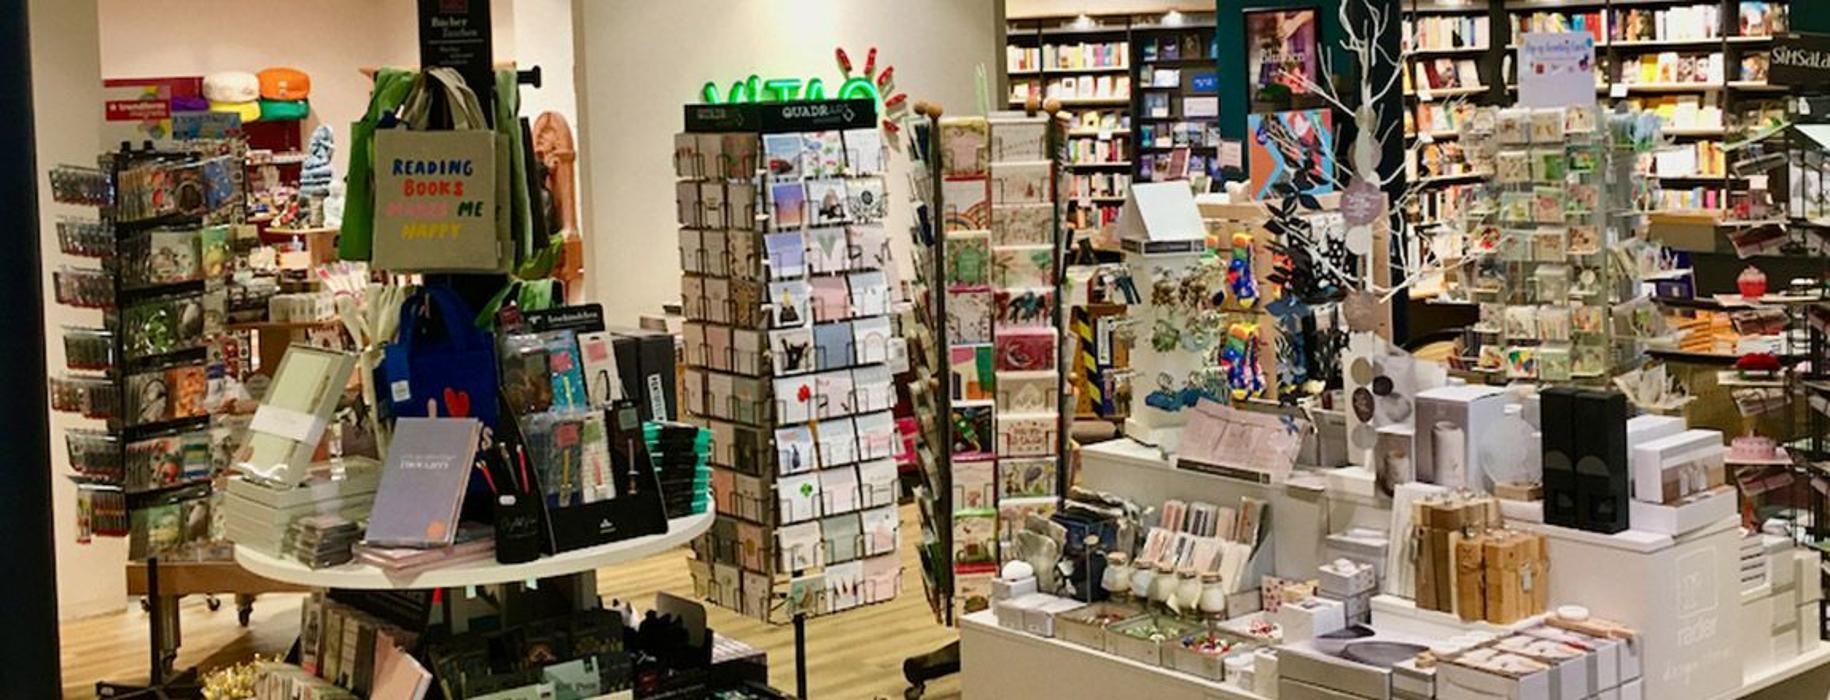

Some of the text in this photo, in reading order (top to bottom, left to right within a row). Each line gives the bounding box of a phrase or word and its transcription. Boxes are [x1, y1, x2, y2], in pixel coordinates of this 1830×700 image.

[392, 159, 473, 176] READING
[404, 178, 464, 197] BOOKS
[458, 201, 484, 217] ME
[402, 222, 462, 239] HAPPY
